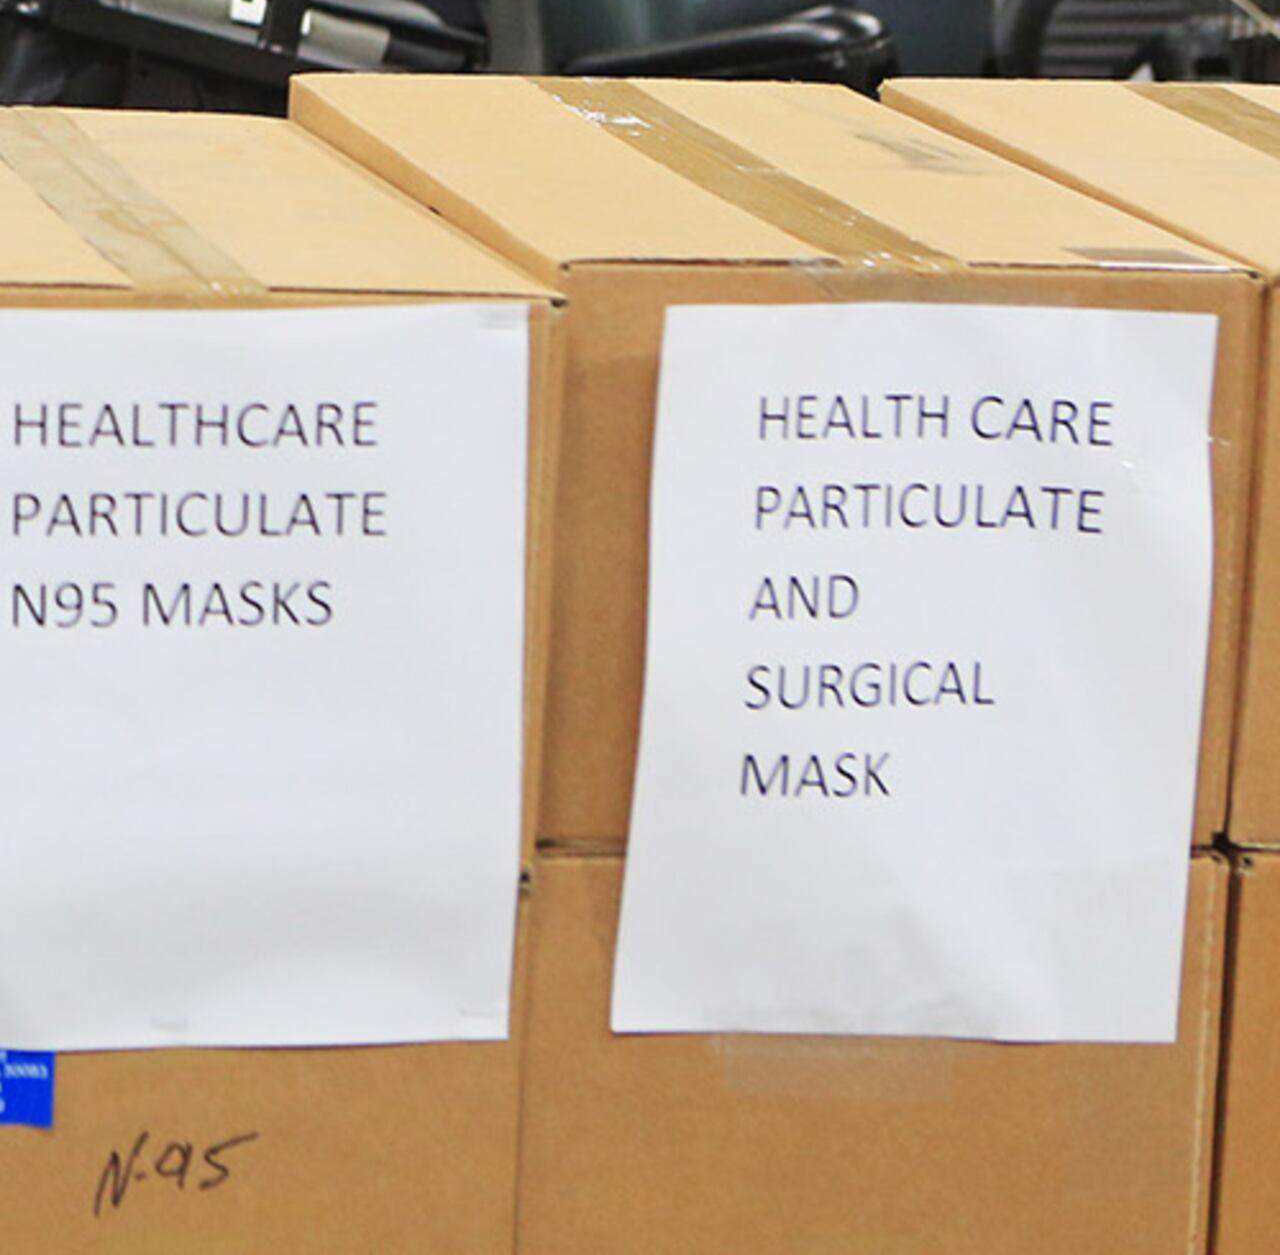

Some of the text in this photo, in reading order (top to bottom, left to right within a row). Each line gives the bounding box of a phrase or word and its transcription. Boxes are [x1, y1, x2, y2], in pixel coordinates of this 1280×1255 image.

[13, 401, 379, 448] HEALTHCARE
[758, 394, 1114, 447] HEALTH CARE
[11, 491, 388, 538] PARTICULATE
[754, 483, 1105, 535] PARTICULATE
[11, 580, 335, 629] N95 MASKS
[748, 574, 860, 621] AND
[744, 661, 995, 710] SURGICAL
[740, 752, 891, 798] MASK
[94, 1131, 259, 1218] N-95
